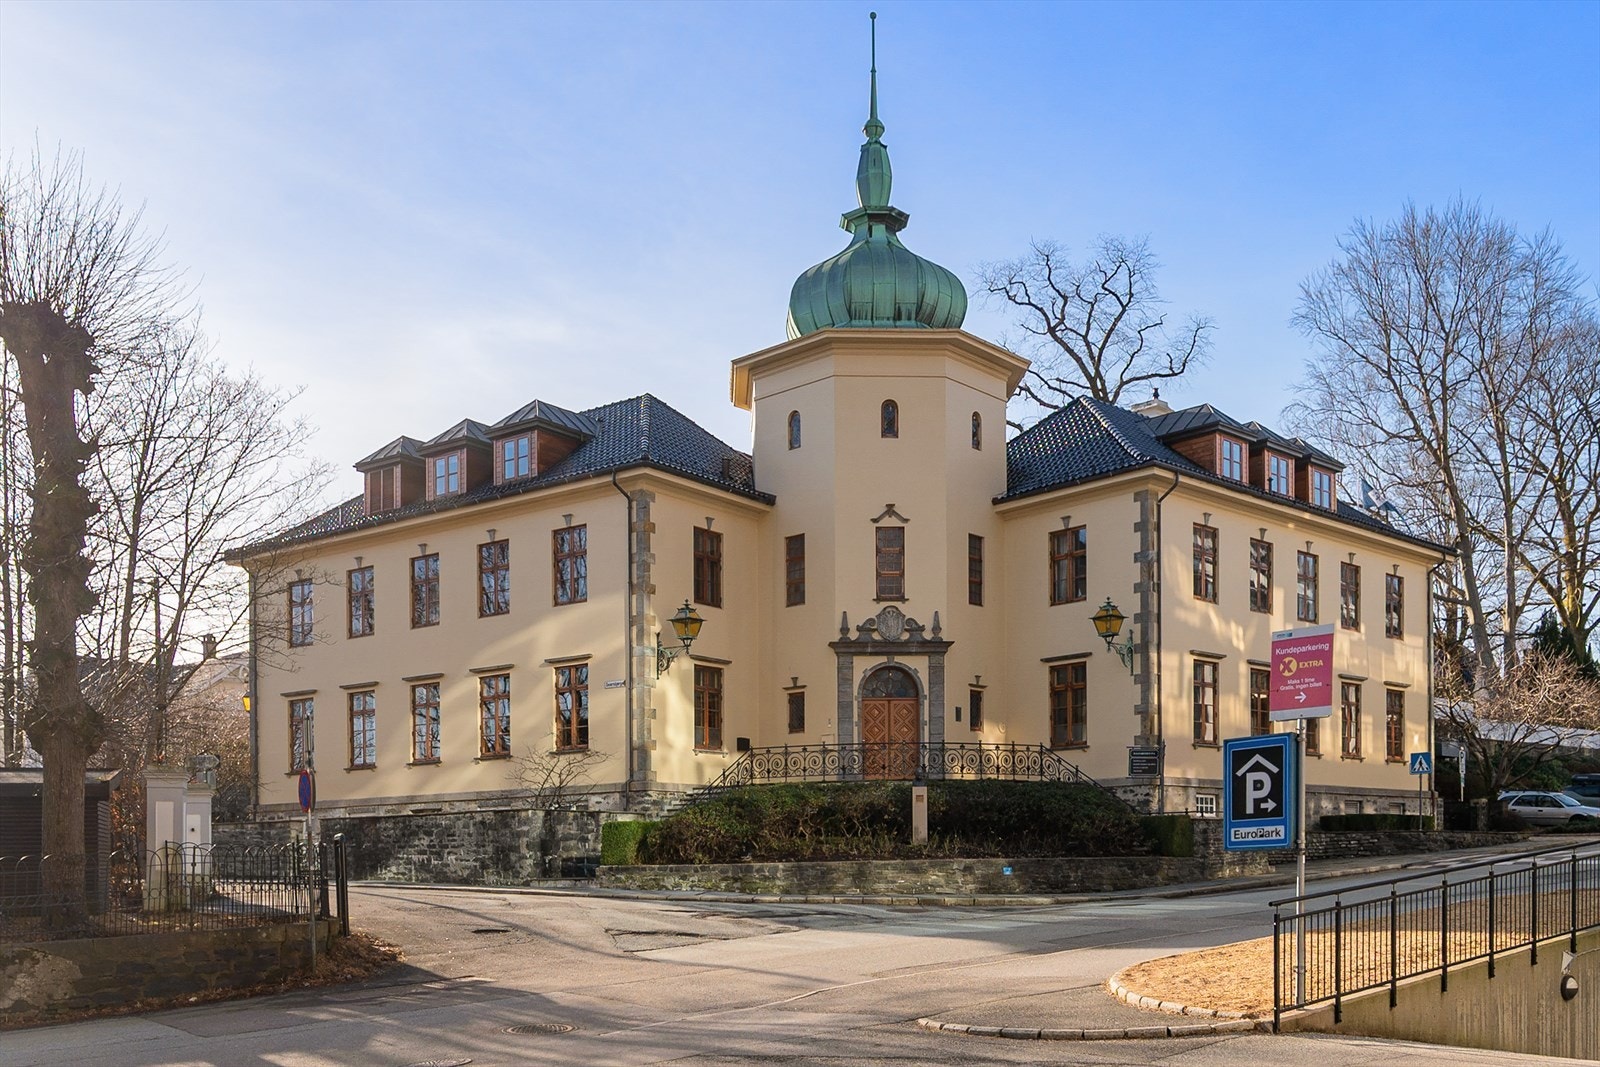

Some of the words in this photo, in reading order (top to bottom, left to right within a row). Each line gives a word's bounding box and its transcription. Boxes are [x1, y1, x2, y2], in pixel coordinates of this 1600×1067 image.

[1276, 643, 1329, 655] Kundeparkering
[1299, 660, 1323, 668] EXTRA
[1245, 771, 1272, 815] P
[1234, 828, 1281, 840] EuroPark
